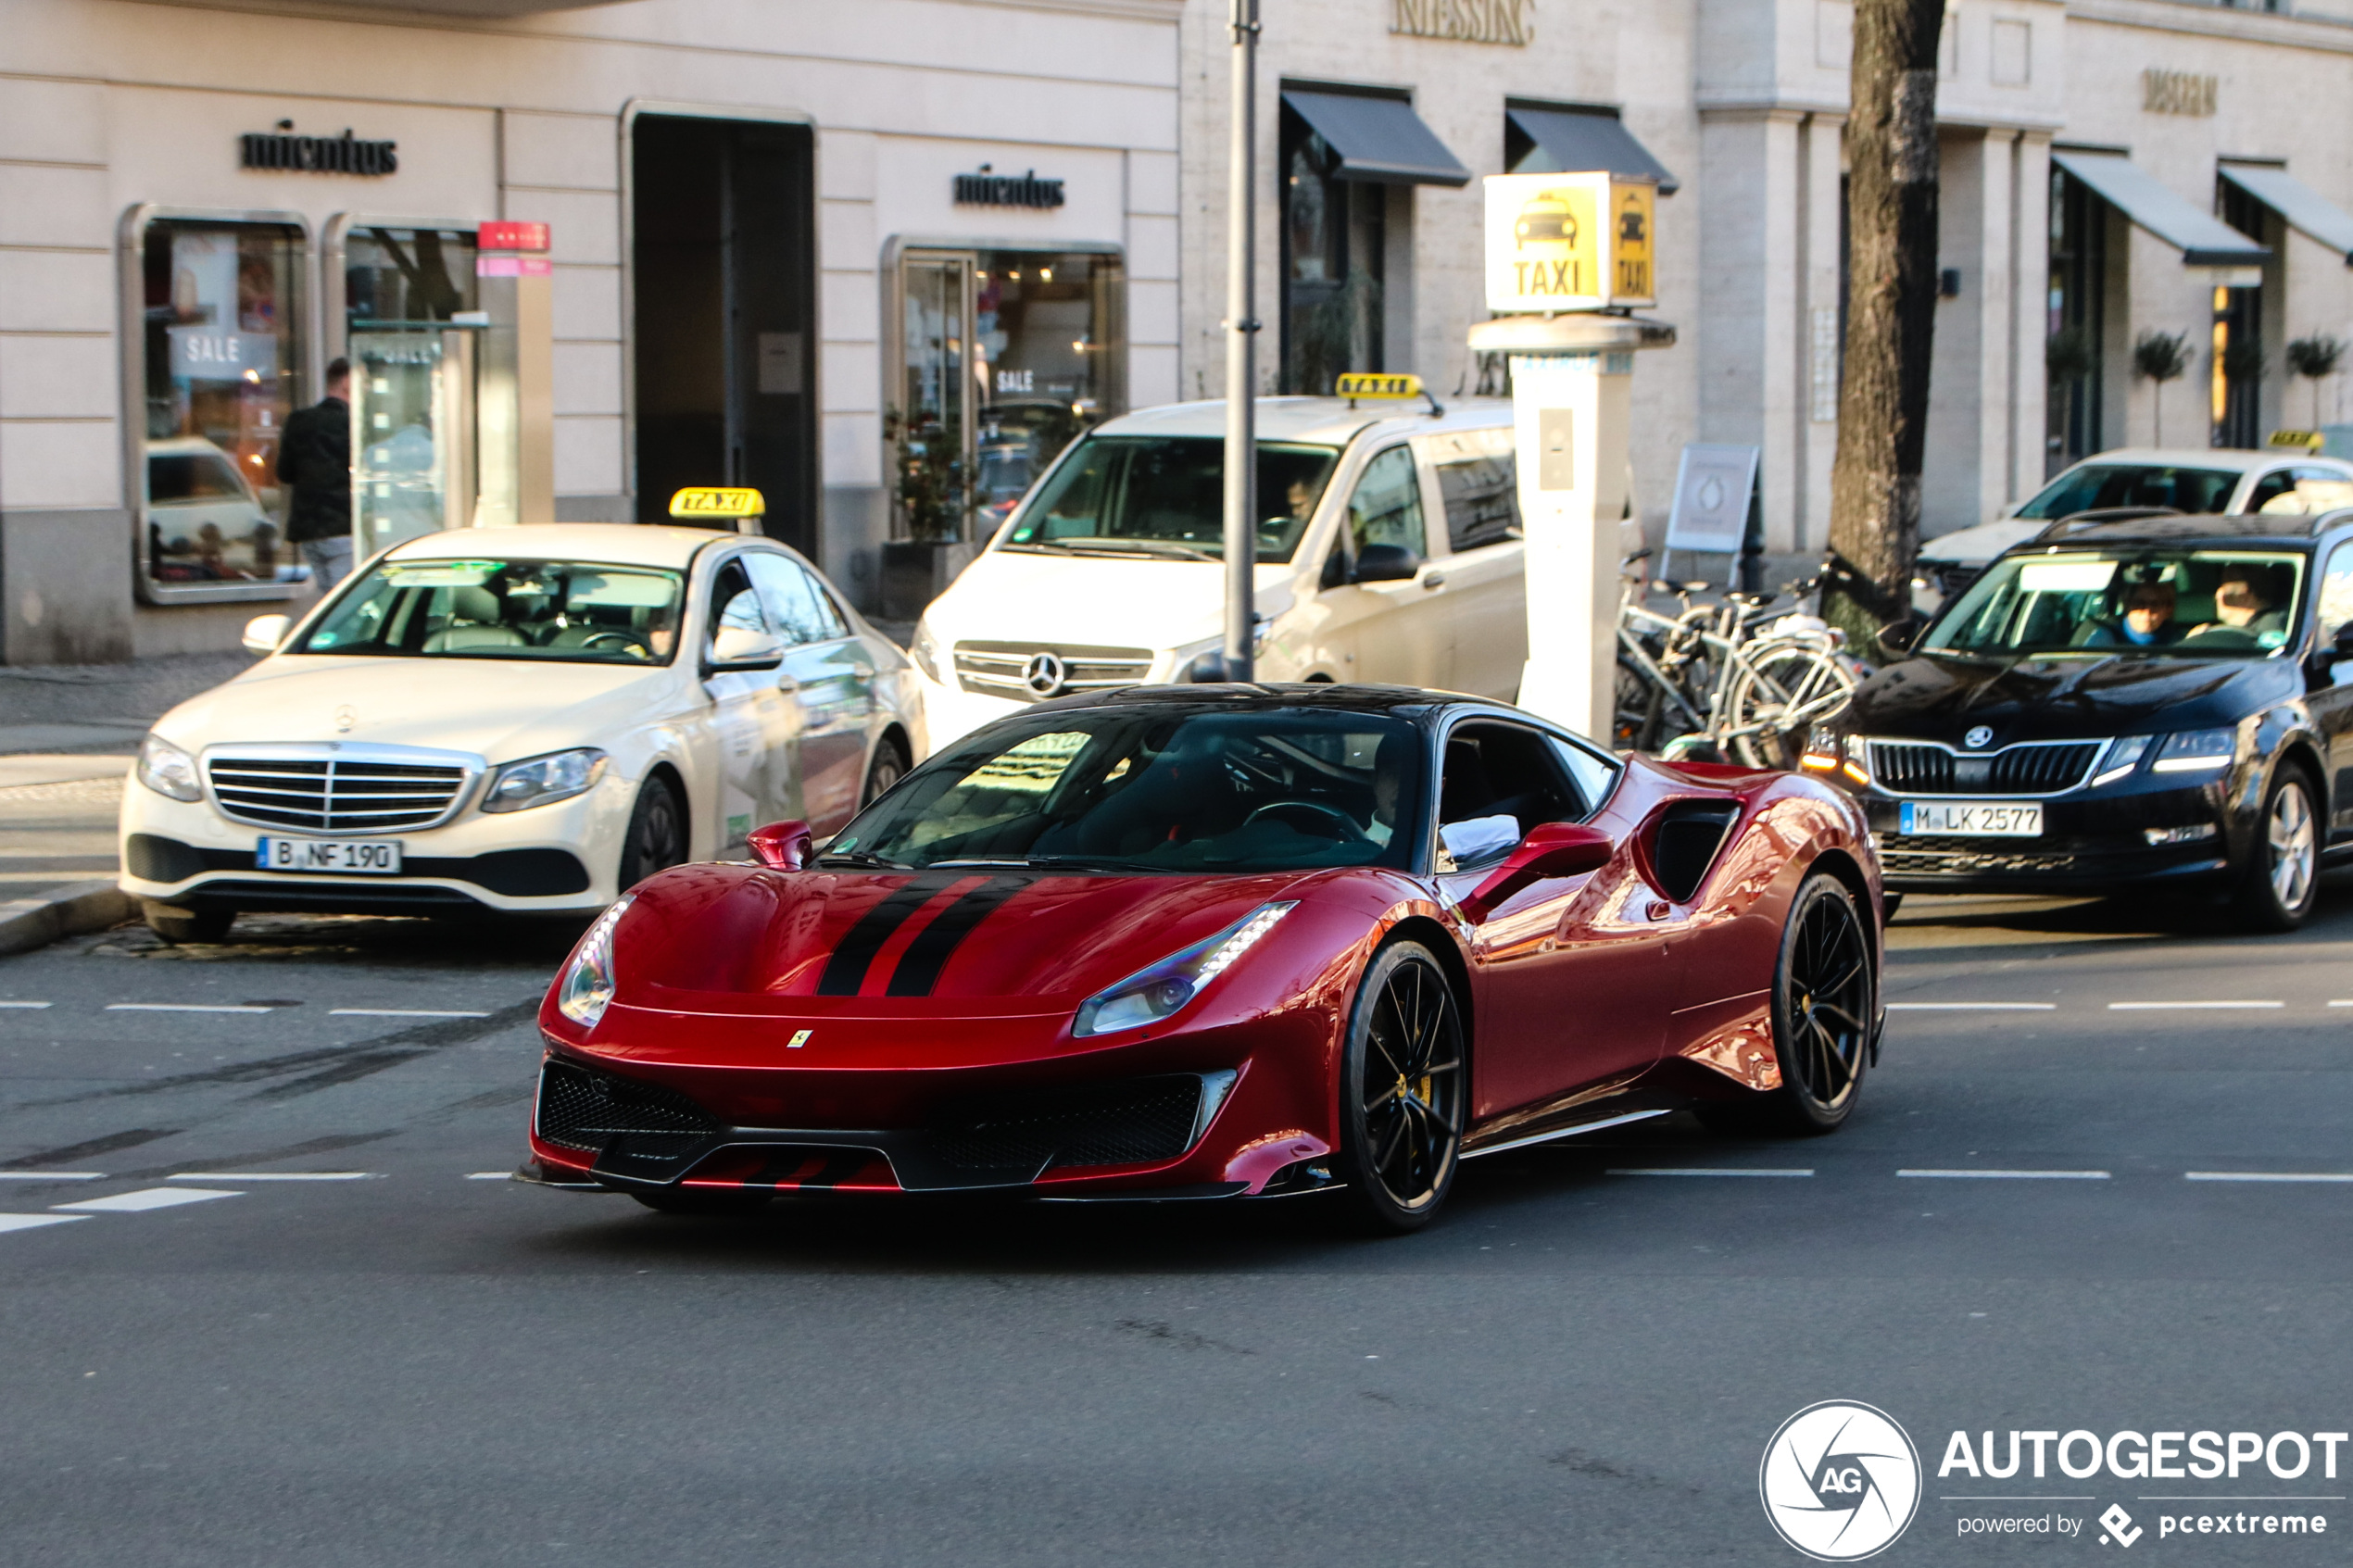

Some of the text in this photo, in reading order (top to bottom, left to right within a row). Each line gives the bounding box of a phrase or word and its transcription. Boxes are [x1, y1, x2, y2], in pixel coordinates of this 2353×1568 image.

[240, 119, 397, 175] mientus
[953, 164, 1065, 207] mientus
[1514, 259, 1579, 295] TAXI
[1618, 259, 1646, 295] TAXI
[186, 335, 240, 362] SALE
[997, 370, 1034, 393] SALE
[1343, 379, 1406, 393] TAXI
[685, 493, 748, 510] TAXI
[1916, 808, 2038, 831] M LK 2577
[280, 842, 390, 868] B NF 190
